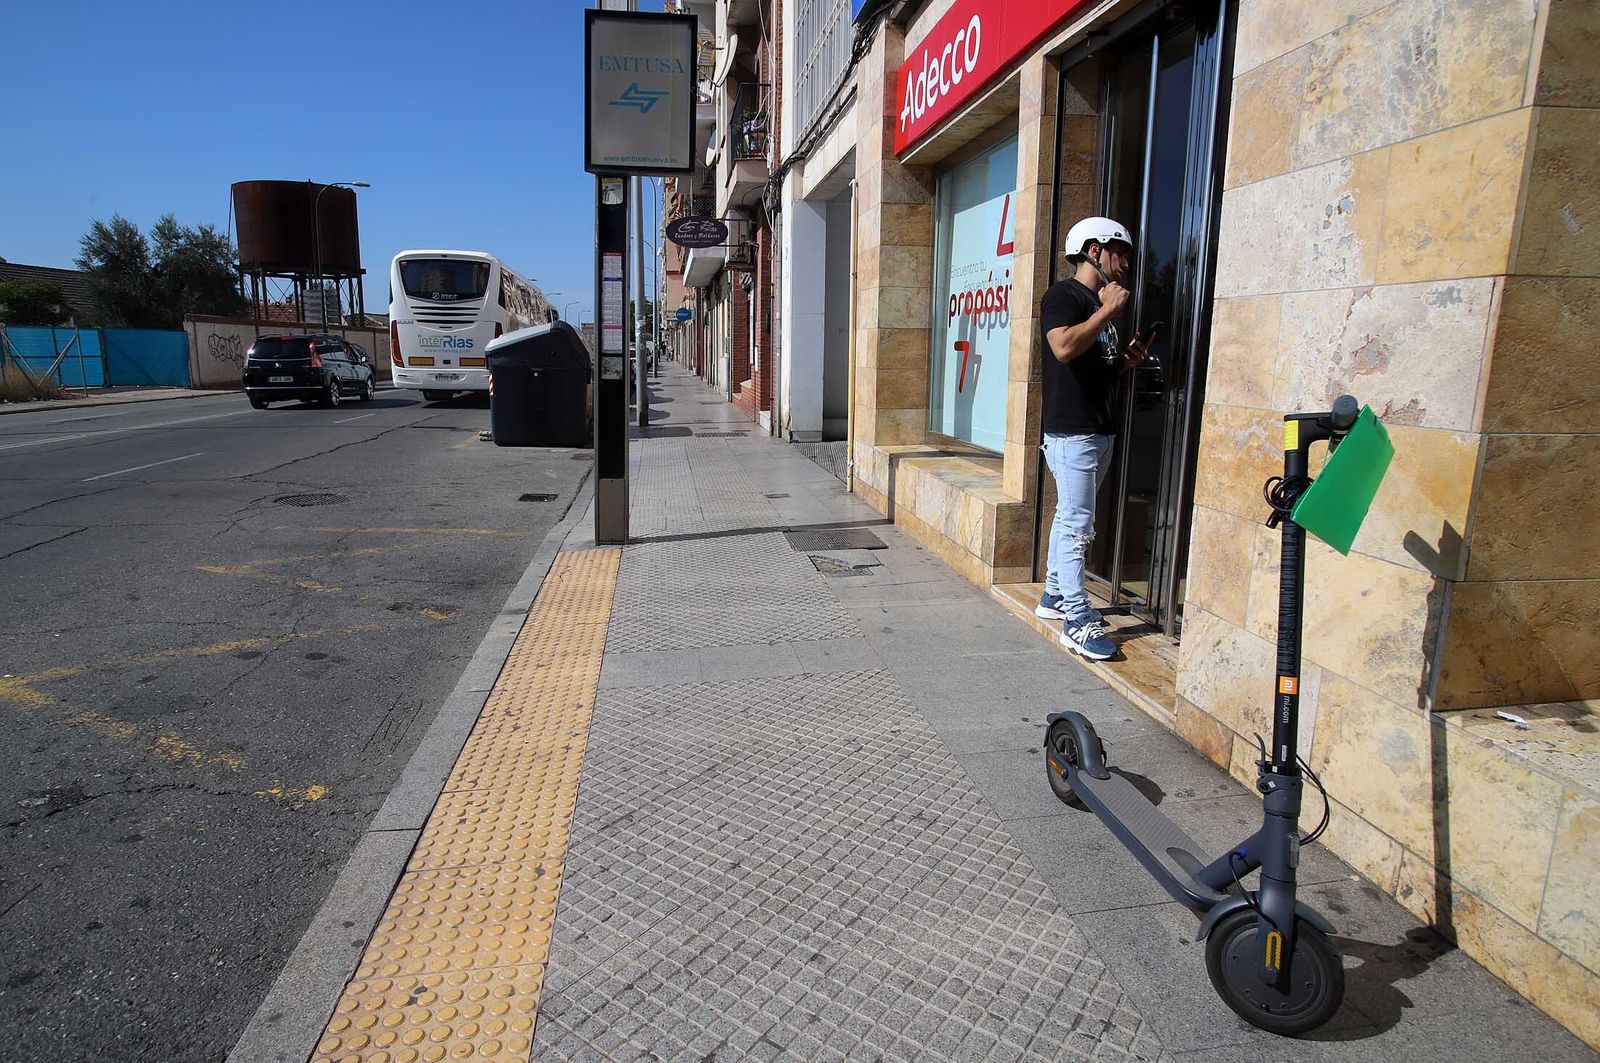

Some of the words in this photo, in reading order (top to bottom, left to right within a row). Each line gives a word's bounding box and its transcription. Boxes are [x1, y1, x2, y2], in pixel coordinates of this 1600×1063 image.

[598, 54, 685, 74] EMTUSA
[900, 14, 981, 133] Adecco
[949, 269, 1013, 328] propósi
[1282, 695, 1292, 724] mi.com
